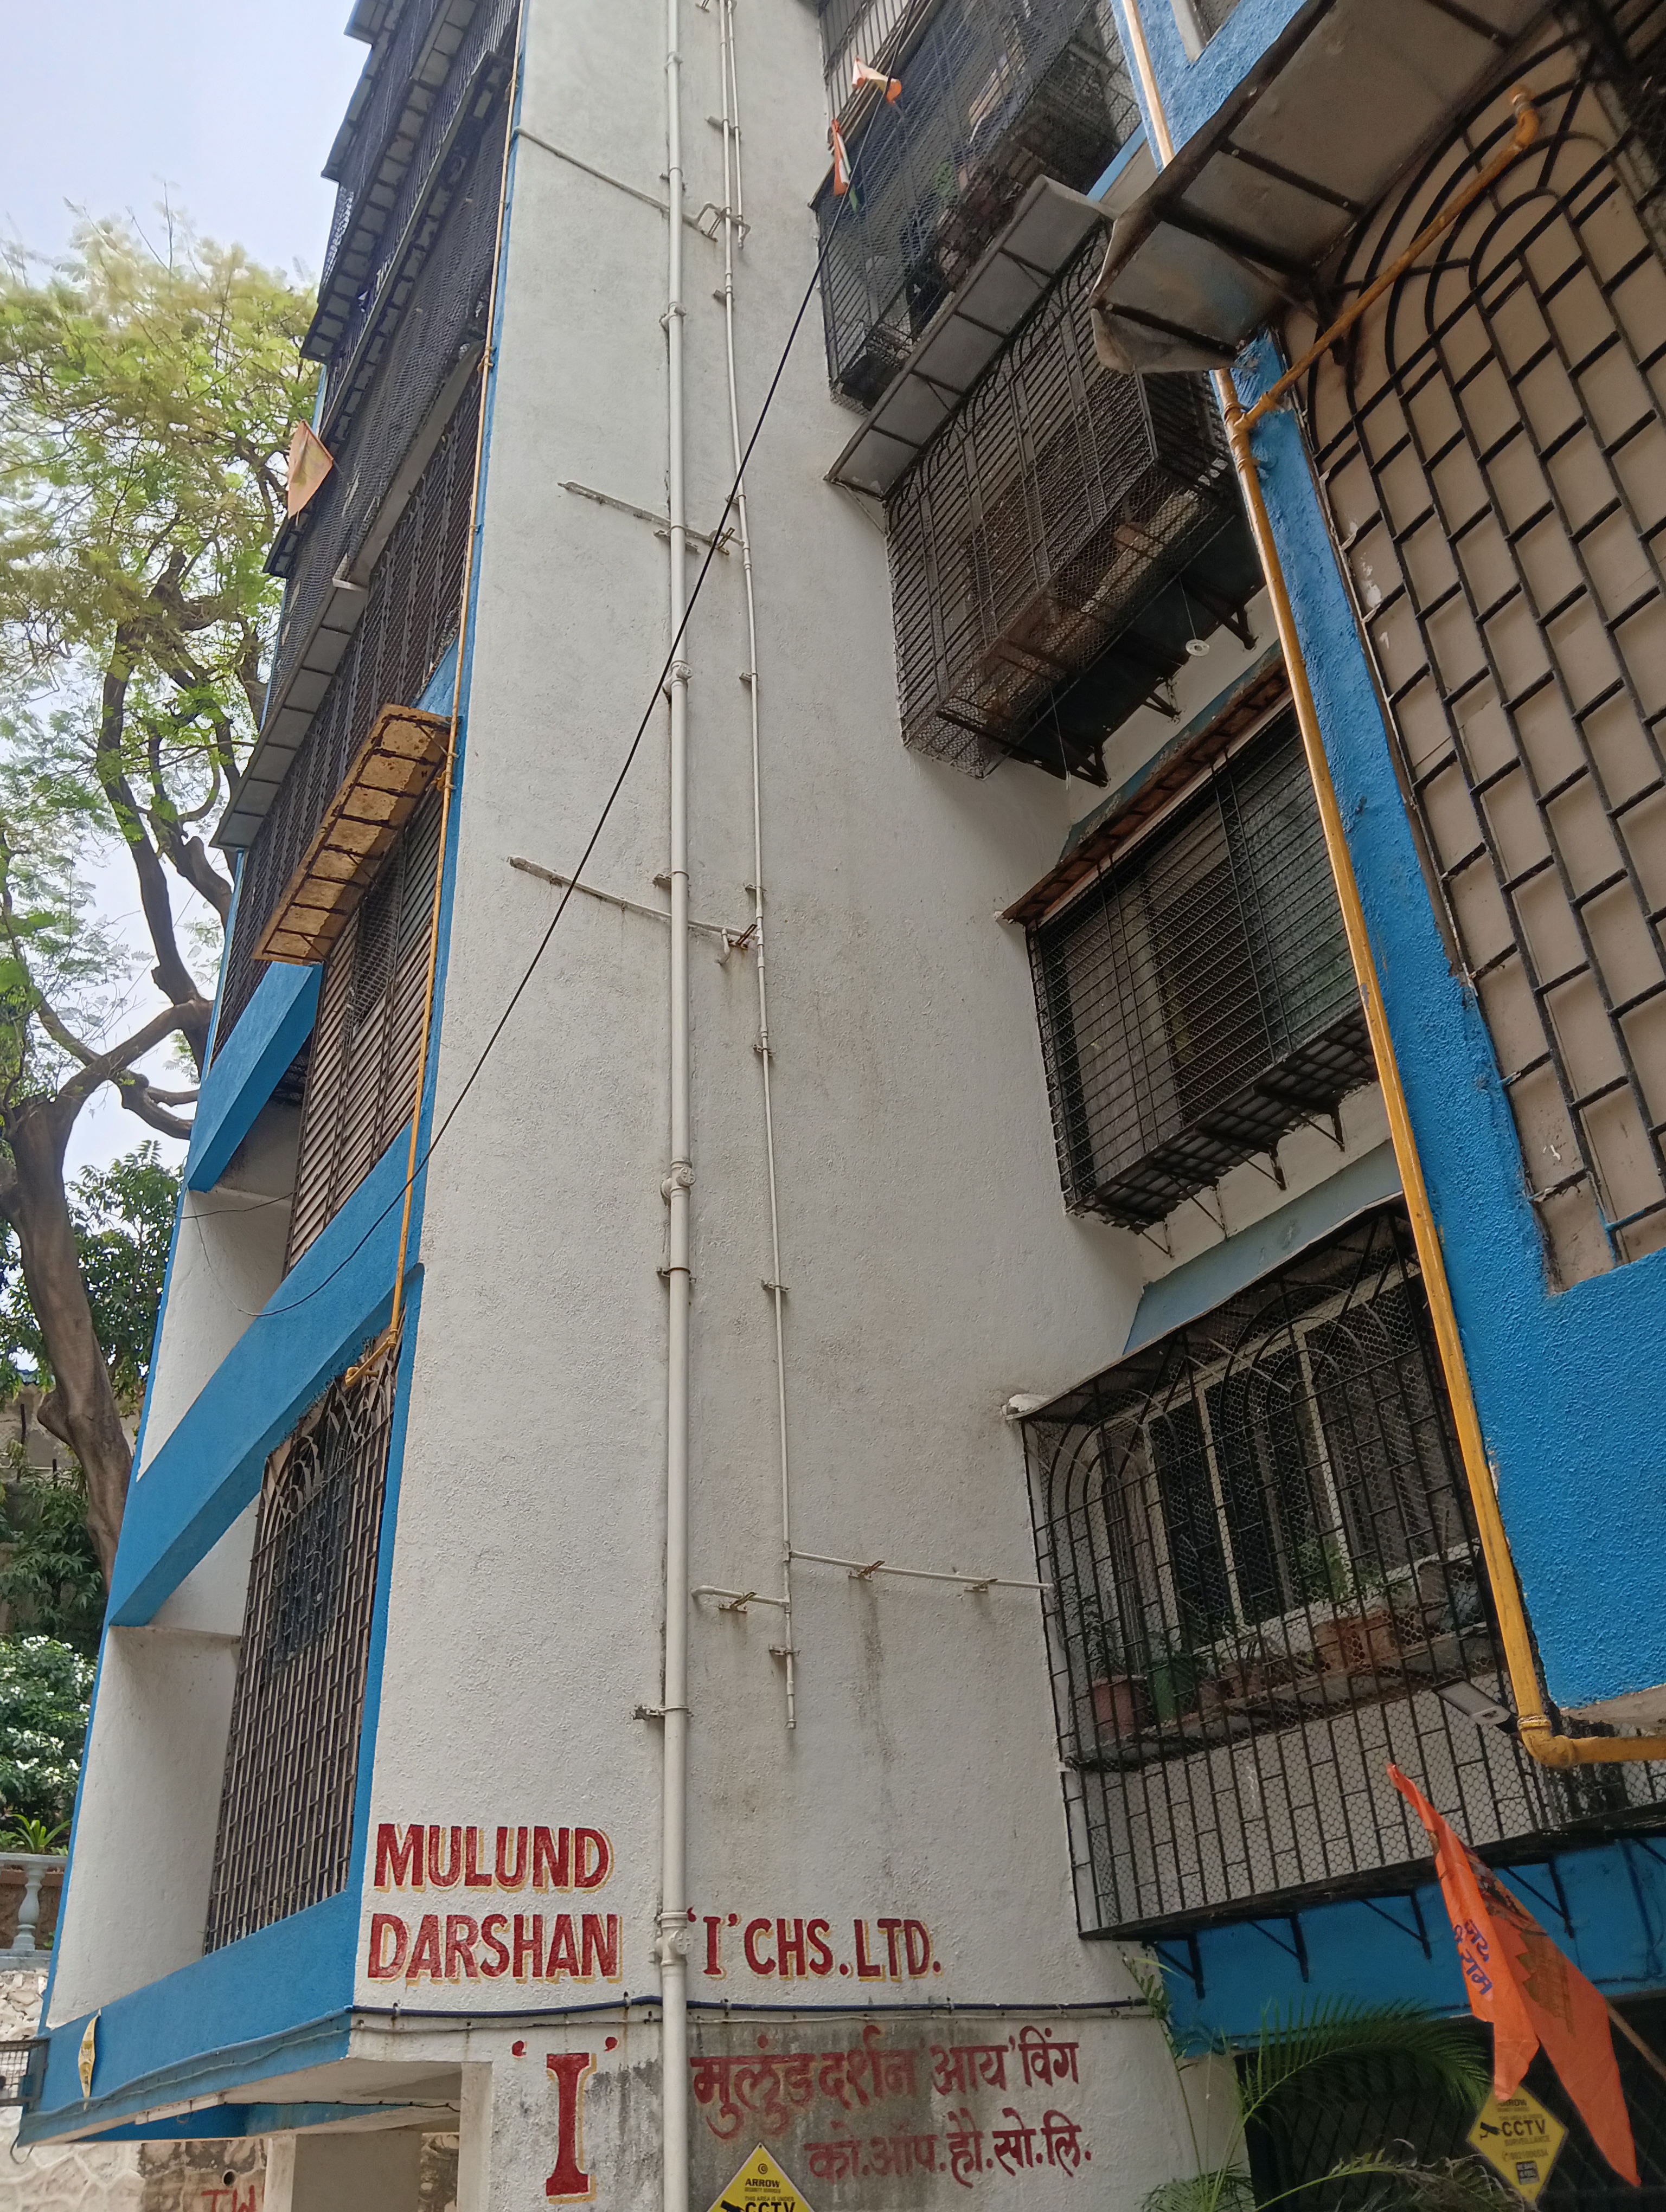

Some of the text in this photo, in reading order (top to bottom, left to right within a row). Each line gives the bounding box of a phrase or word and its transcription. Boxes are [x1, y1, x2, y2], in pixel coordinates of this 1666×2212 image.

[374, 1823, 613, 1891] MULUND
[367, 1913, 621, 1982] DARSHAN
[1018, 2025, 1080, 2088] विंग
[1502, 2119, 1546, 2137] CCTV
[745, 2178, 780, 2188] ARROW
